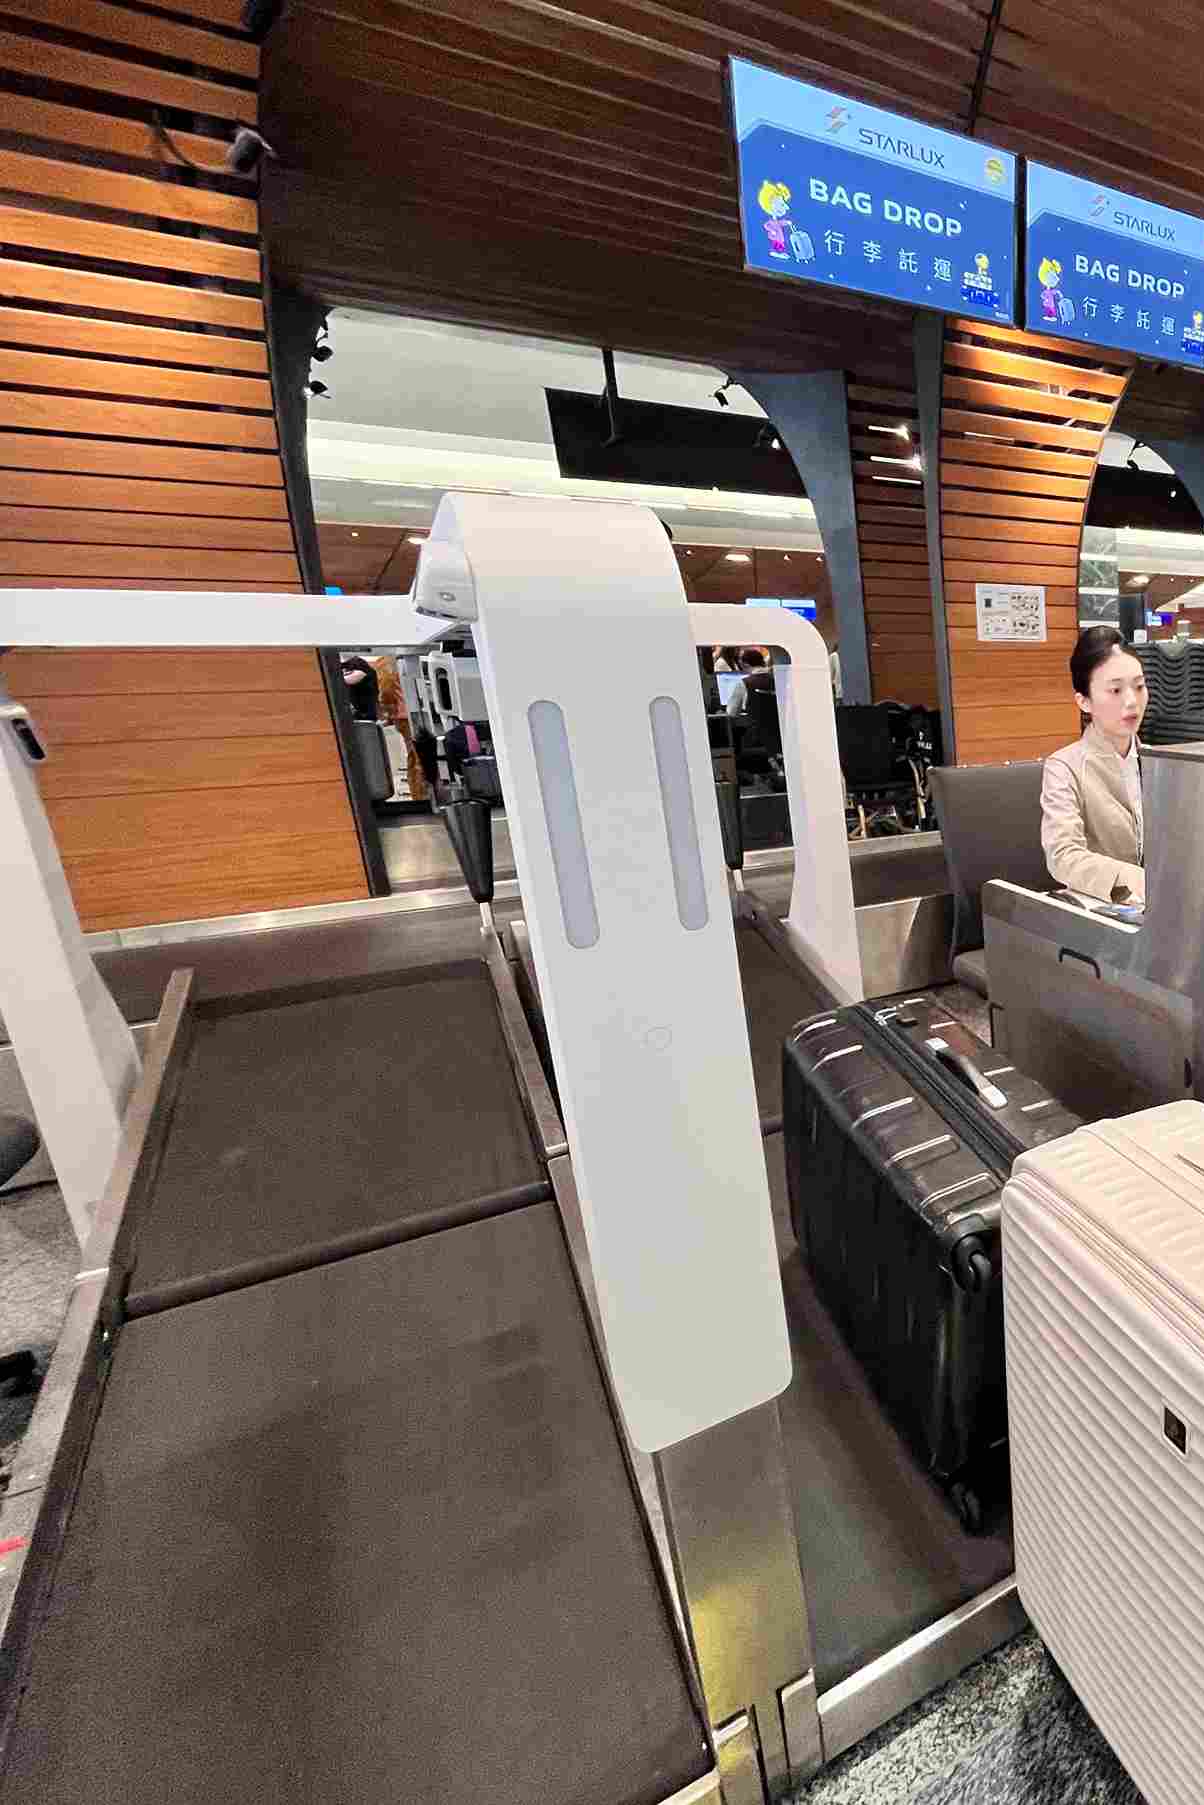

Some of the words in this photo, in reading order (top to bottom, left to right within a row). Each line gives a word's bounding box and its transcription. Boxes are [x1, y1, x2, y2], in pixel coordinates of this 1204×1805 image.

[858, 128, 945, 169] STARLUX
[809, 177, 873, 215] BAG
[884, 199, 962, 237] DROP
[1113, 211, 1176, 241] STARLUX
[824, 229, 952, 282] 行李託運
[1075, 254, 1120, 283] BAG
[1127, 269, 1185, 298] DROP
[1083, 296, 1176, 336] 行李託運
